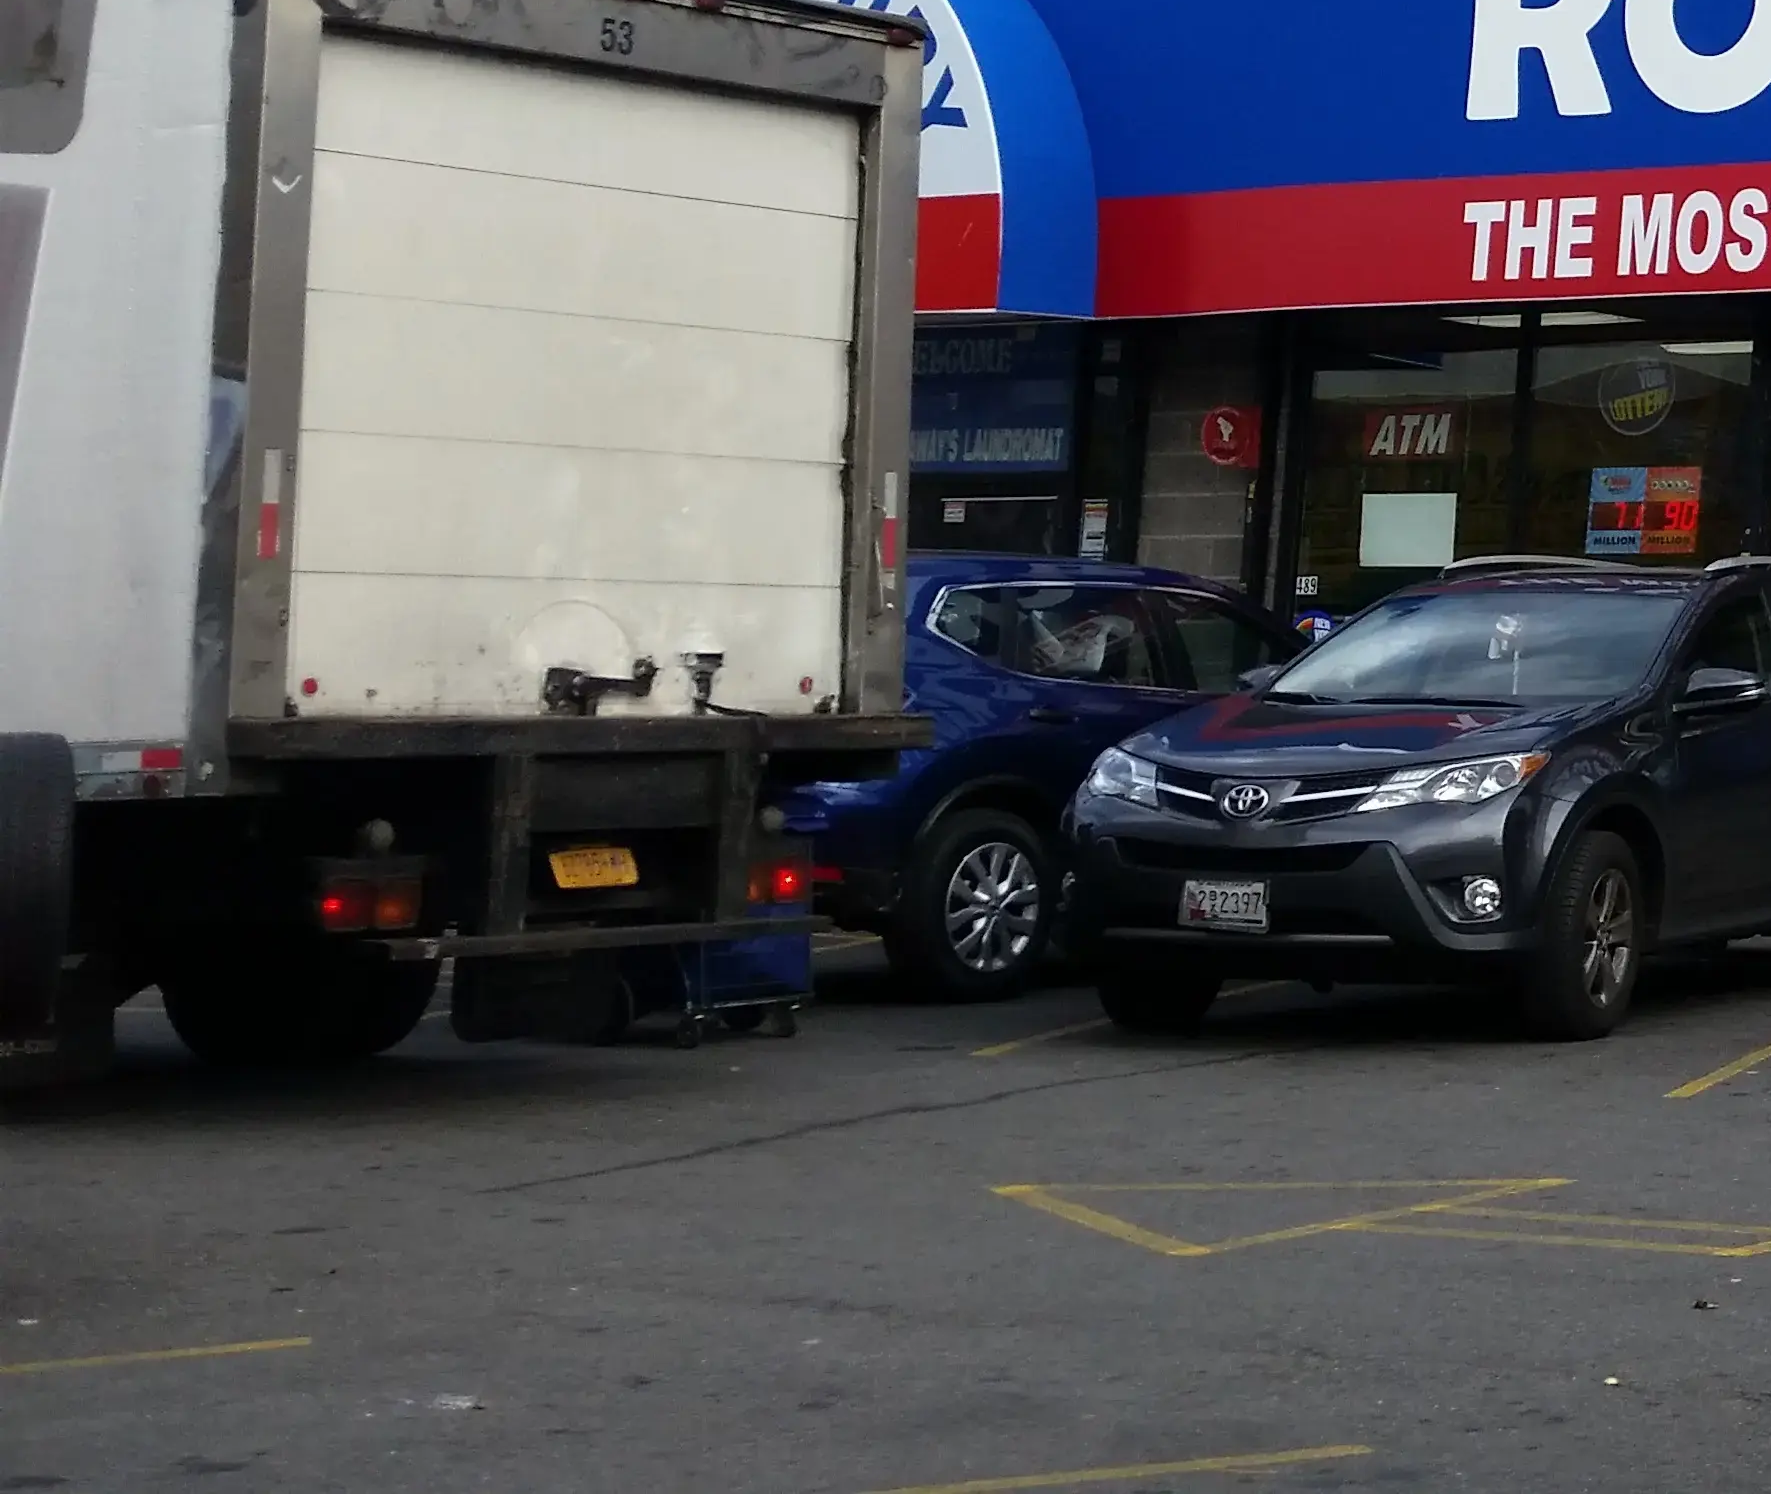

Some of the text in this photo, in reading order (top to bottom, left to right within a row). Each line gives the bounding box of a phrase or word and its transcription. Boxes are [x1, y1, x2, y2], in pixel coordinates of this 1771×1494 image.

[600, 17, 636, 55] 53
[1462, 195, 1596, 282] THE
[913, 338, 1013, 375] ELCOME
[1369, 413, 1451, 456] ATM
[1593, 536, 1637, 546] MILLION
[1647, 536, 1691, 546] MILLION
